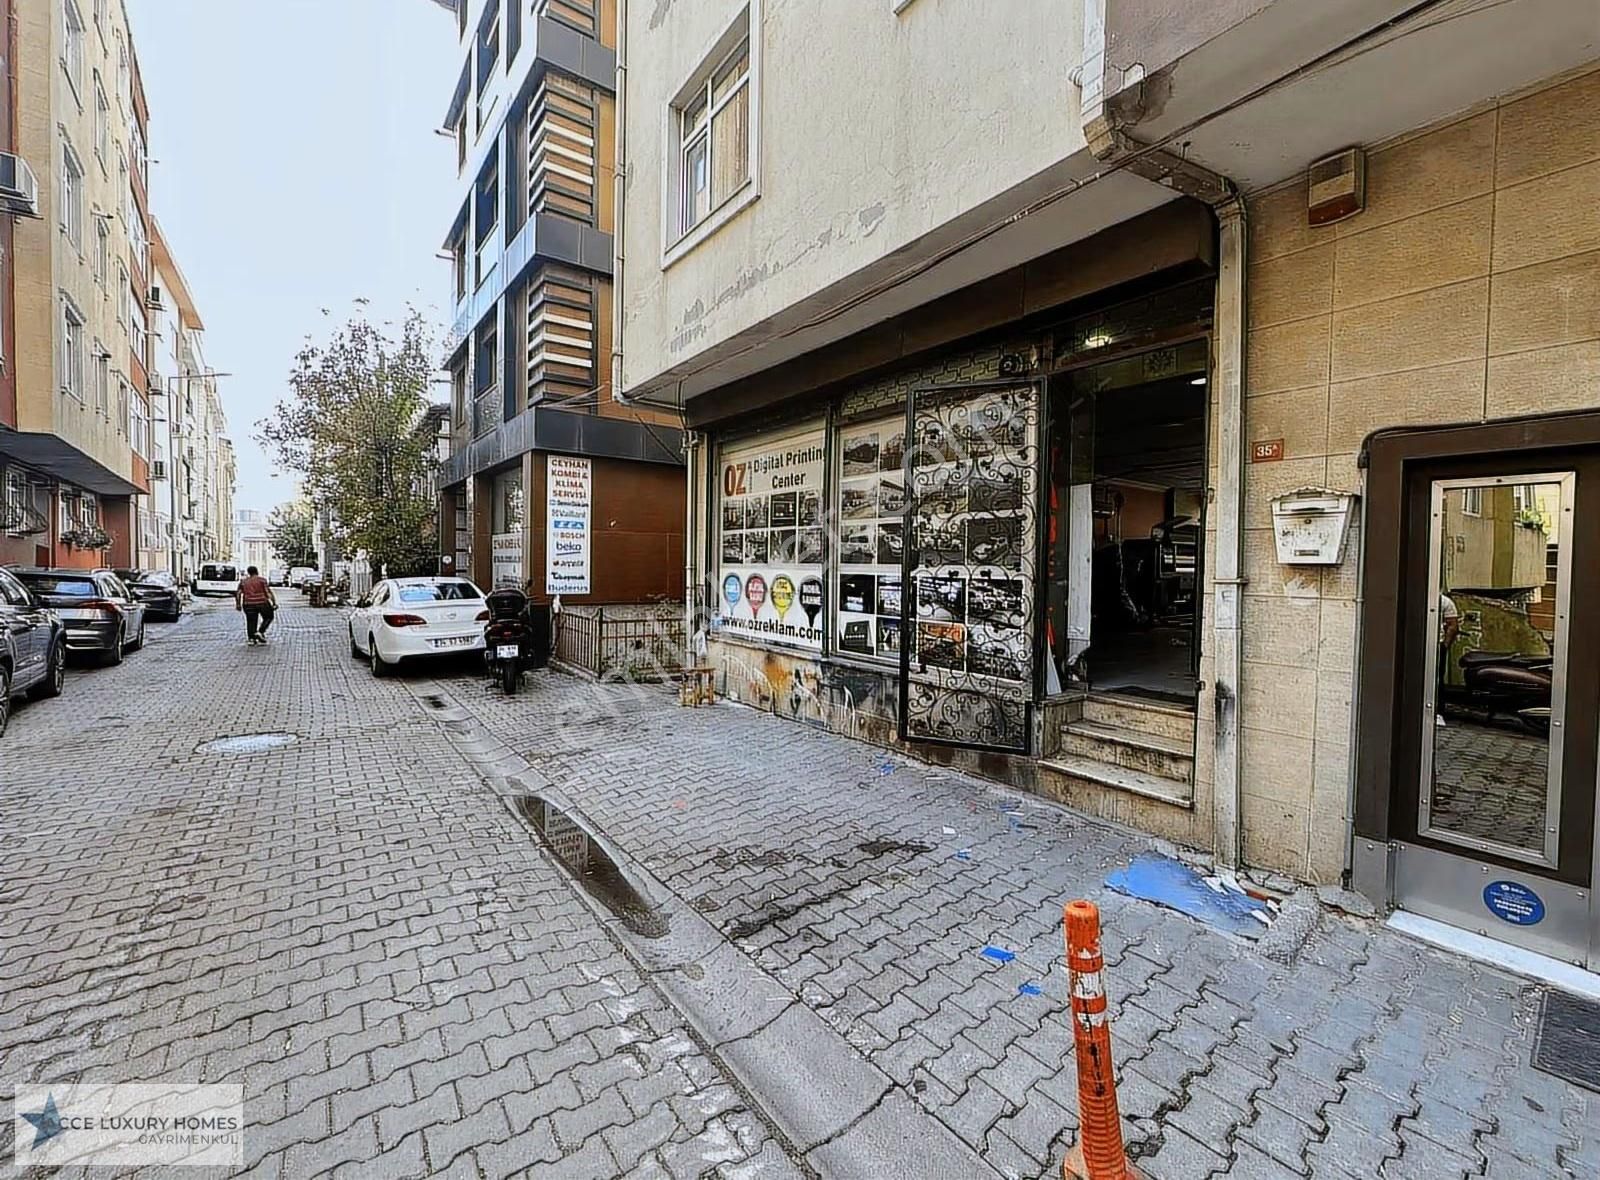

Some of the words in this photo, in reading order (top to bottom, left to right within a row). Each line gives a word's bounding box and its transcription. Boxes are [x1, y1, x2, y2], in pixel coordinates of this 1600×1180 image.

[552, 459, 588, 470] CEYHAN
[754, 453, 784, 474] Digital
[555, 479, 584, 489] KLİMA
[772, 472, 806, 489] Center
[556, 541, 582, 551] beko
